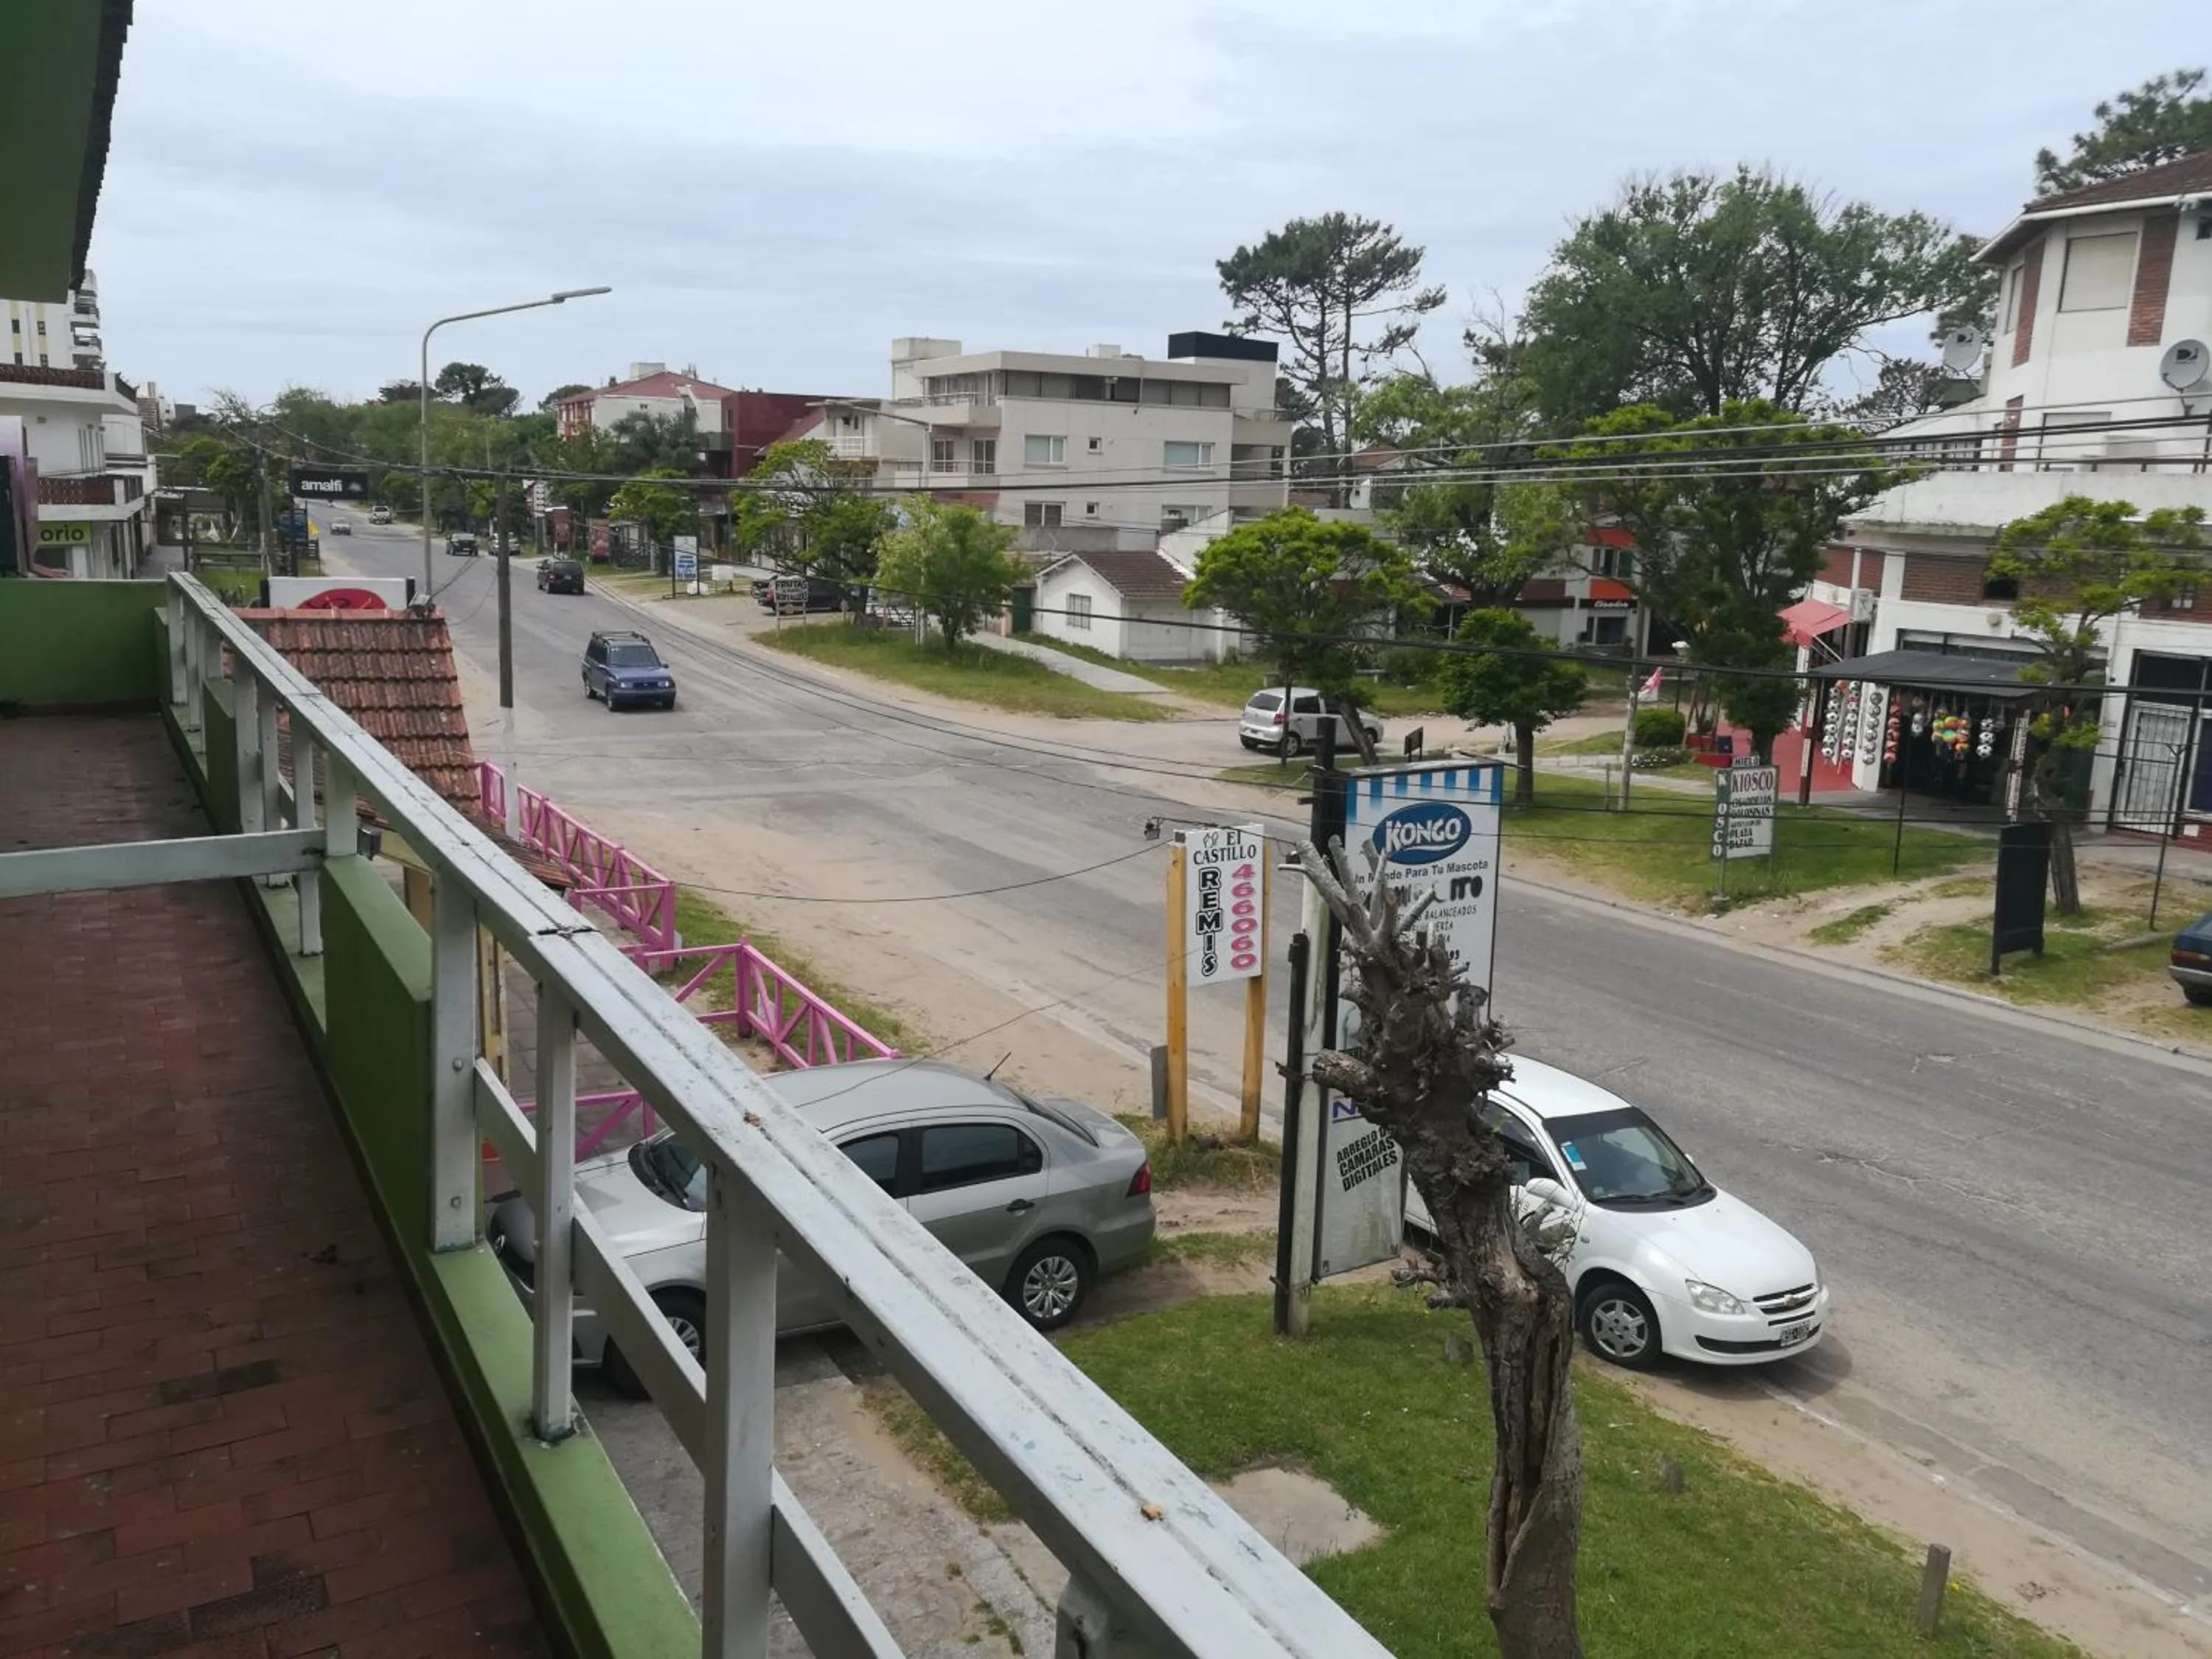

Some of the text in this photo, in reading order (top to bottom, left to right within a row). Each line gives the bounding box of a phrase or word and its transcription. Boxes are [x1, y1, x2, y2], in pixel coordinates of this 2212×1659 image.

[301, 479, 342, 492] amalfi
[1732, 771, 1773, 793] KIOSCO
[1385, 818, 1462, 852] KONGO
[1194, 844, 1256, 865] CASTILLO
[1405, 867, 1428, 877] Para
[1431, 864, 1444, 874] Tu
[1447, 860, 1488, 873] Mascota
[1196, 867, 1224, 976] REMIS
[1337, 1130, 1377, 1164] ARREGLO
[1340, 1137, 1394, 1178] CAMARAS
[1343, 1150, 1397, 1192] DIGITALES
